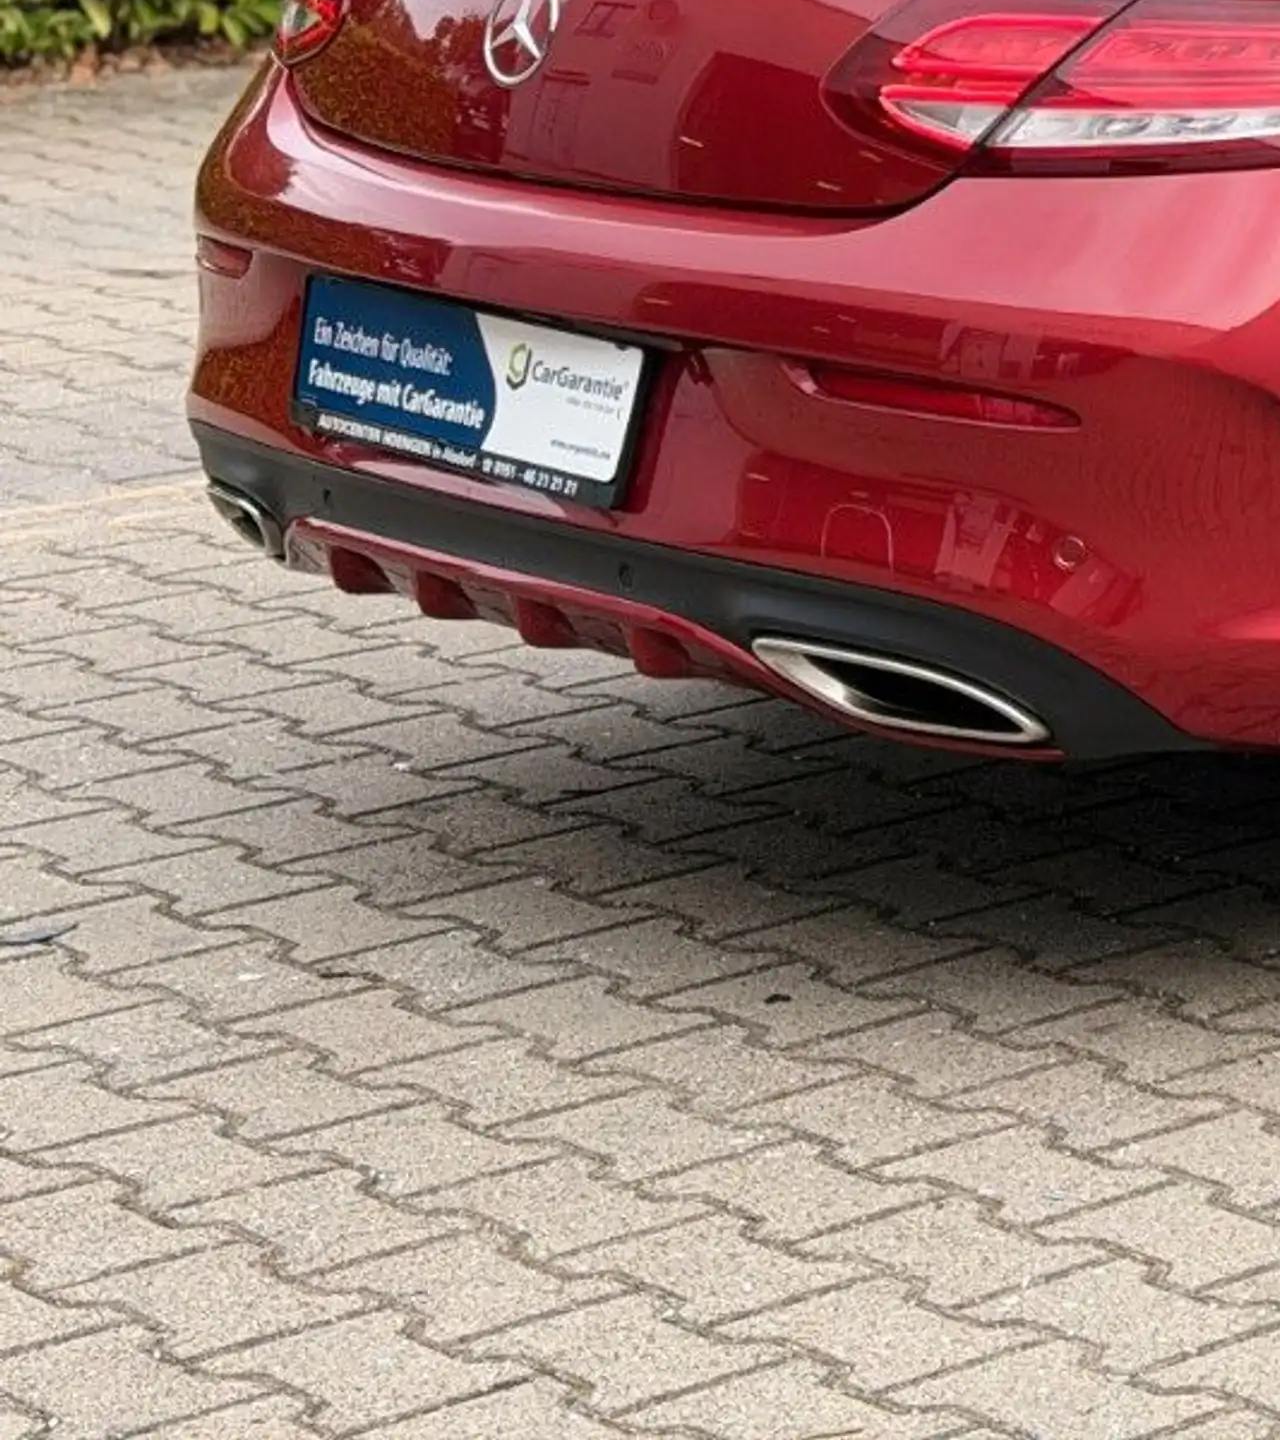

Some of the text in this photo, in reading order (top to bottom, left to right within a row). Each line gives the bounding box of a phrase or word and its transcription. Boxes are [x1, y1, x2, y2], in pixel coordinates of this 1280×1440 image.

[314, 316, 333, 347] Ein
[333, 321, 380, 359] Zeichen
[381, 332, 400, 363] für
[308, 357, 485, 429] Fahrzeuge mit CarGarantie
